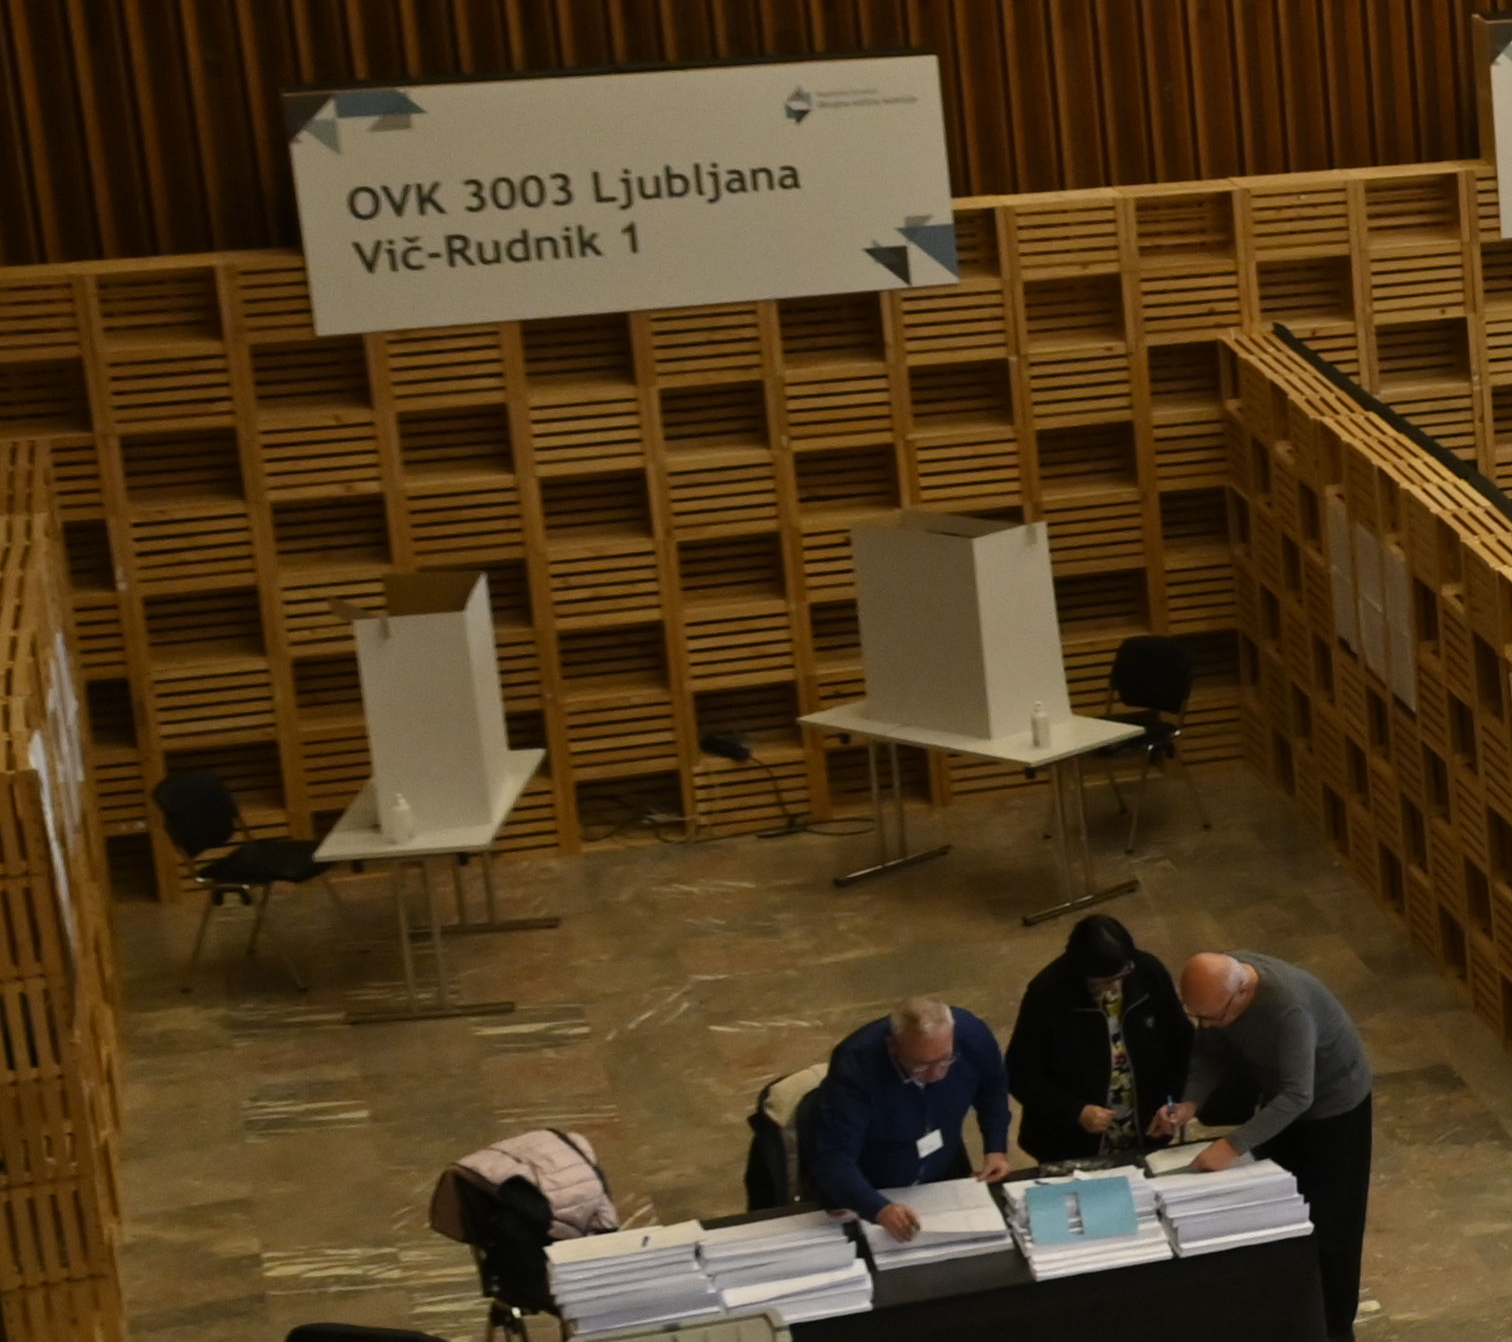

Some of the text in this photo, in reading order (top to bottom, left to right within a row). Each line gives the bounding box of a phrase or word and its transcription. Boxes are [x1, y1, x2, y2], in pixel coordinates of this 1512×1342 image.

[347, 162, 801, 221] OVK 3003 Ljubljana
[351, 221, 639, 275] Vič-Rudnik 1
